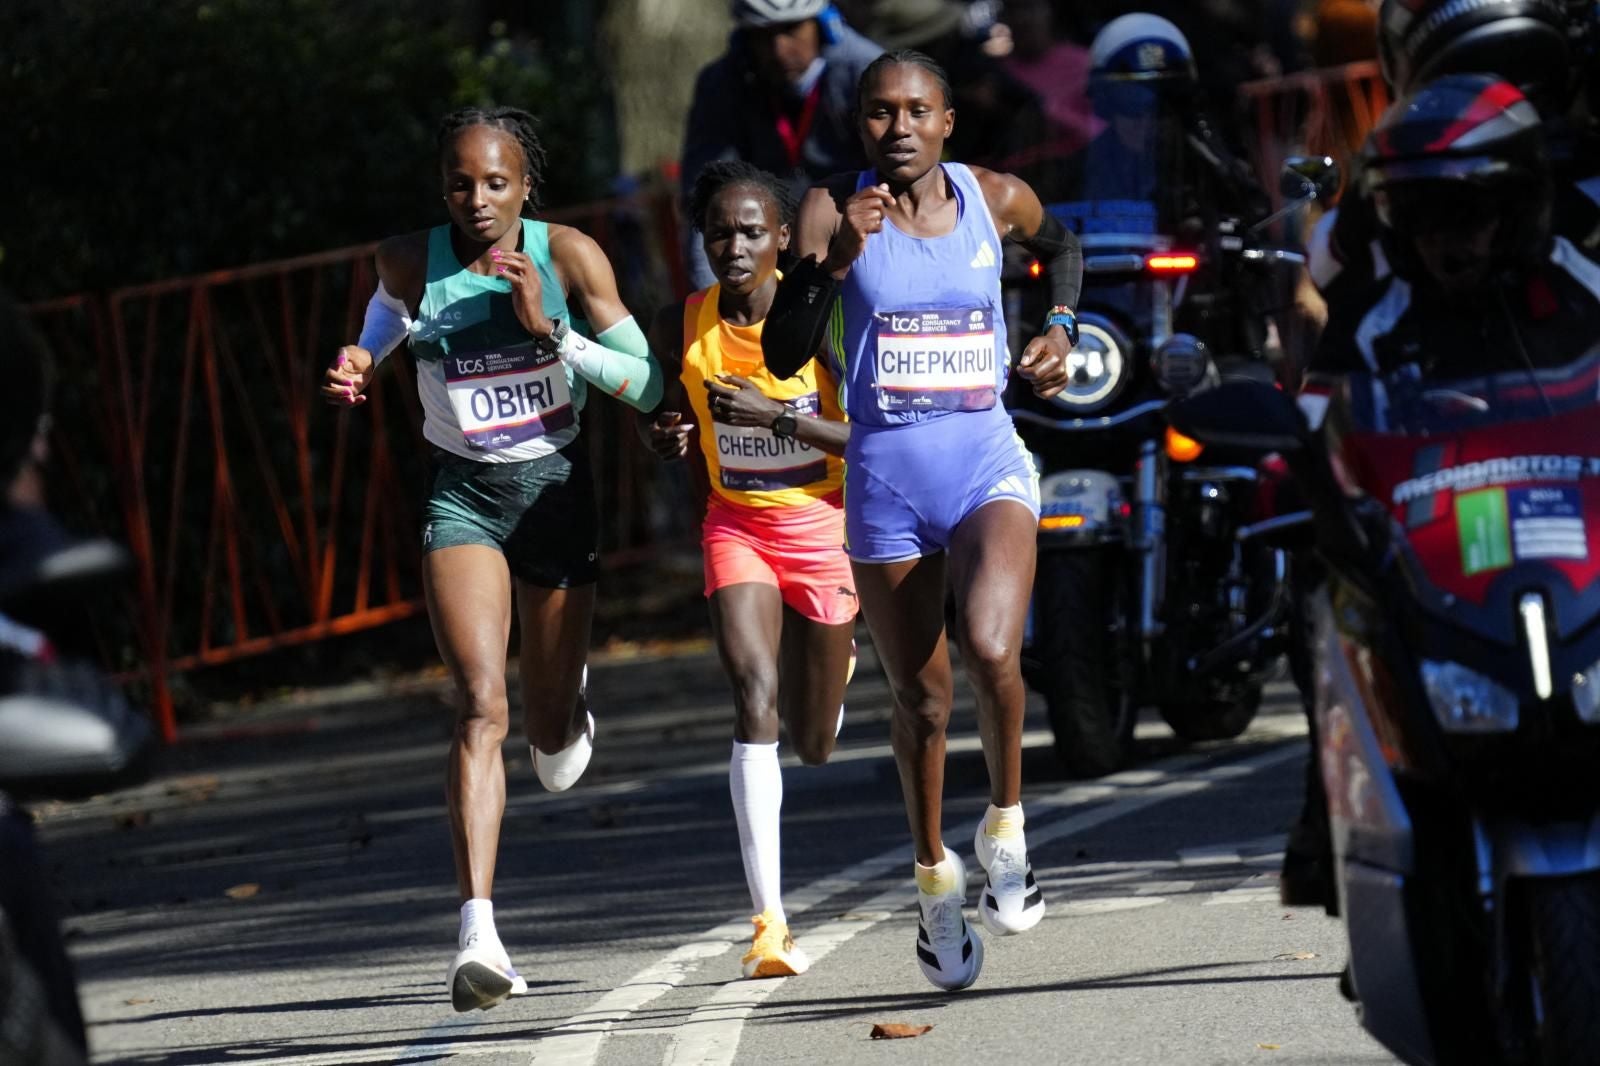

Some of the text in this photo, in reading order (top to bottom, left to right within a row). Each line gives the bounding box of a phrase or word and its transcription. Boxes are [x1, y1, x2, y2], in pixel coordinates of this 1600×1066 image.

[892, 314, 920, 332] tcs
[968, 323, 985, 331] TATA
[486, 356, 525, 366] CONSULTANCY
[536, 353, 555, 364] TATA
[881, 348, 992, 374] CHEPKIRUI
[456, 358, 485, 374] tcs
[487, 364, 513, 372] SERVICES
[470, 376, 554, 422] OBIRI
